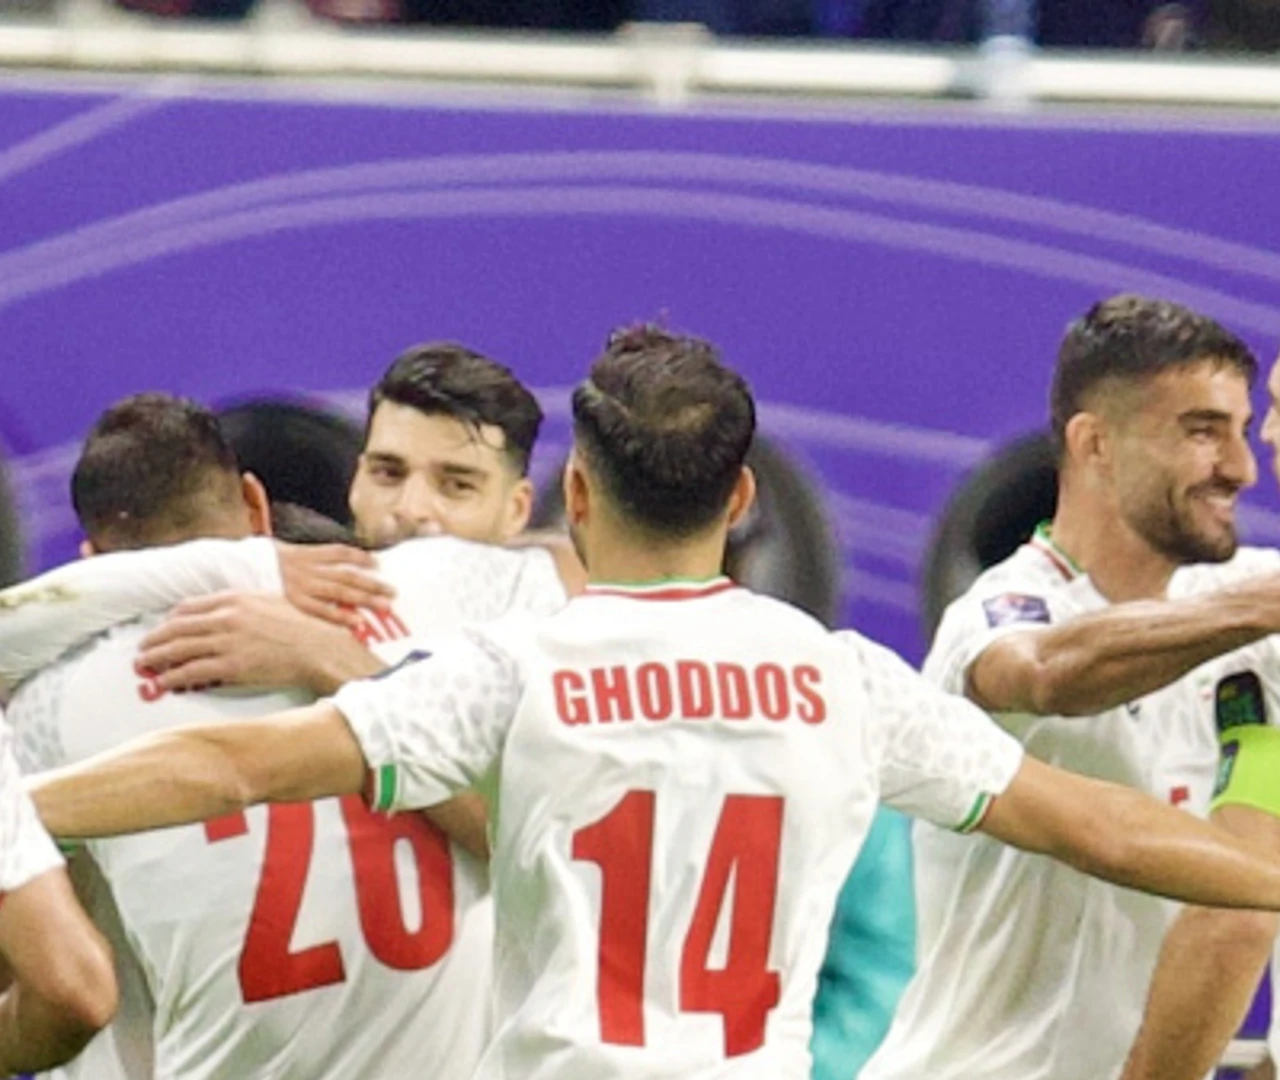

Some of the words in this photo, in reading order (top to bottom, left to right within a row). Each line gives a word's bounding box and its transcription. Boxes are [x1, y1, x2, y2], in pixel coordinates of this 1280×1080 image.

[552, 660, 827, 726] GHODDOS
[205, 792, 457, 1005] 26
[570, 789, 786, 1059] 14
